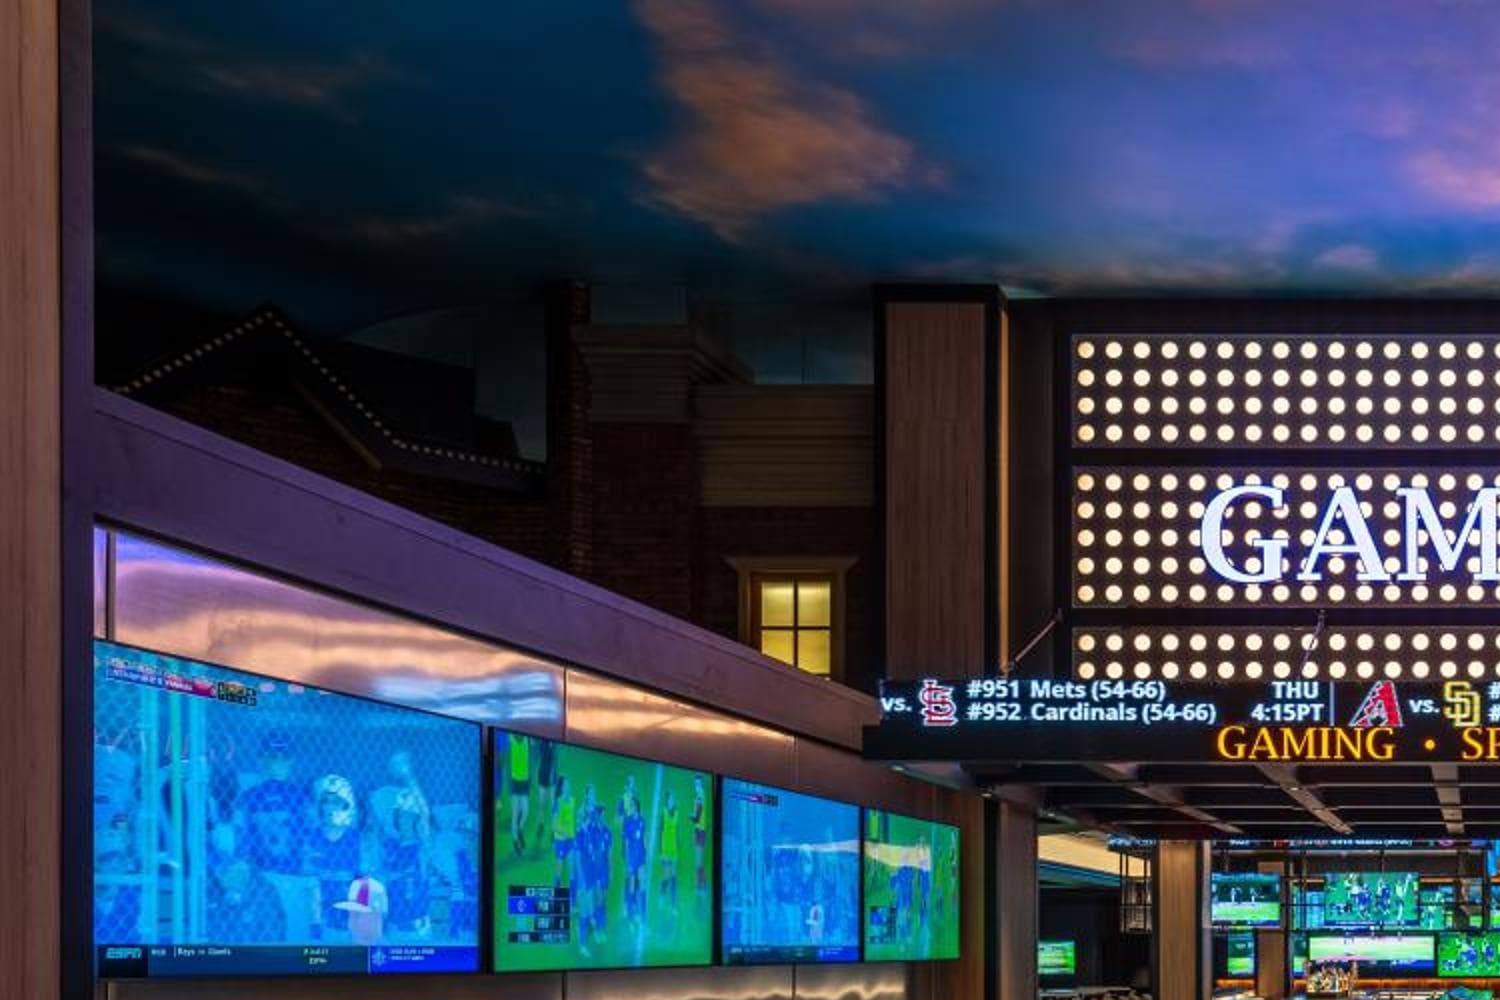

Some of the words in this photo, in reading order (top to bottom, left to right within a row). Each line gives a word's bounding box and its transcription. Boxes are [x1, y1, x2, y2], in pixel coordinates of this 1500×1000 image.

[966, 680, 1020, 699] #951
[1030, 680, 1086, 699] Mets
[1091, 681, 1166, 702] (54-66)
[1271, 681, 1319, 699] THU
[881, 697, 912, 712] vs.
[966, 703, 1021, 721] #952
[1030, 702, 1137, 721] Cardinals
[1142, 703, 1217, 724] (54-66)
[1250, 703, 1324, 721] 4:15PT
[1409, 699, 1440, 714] vs.
[1217, 725, 1395, 760] GAMING
